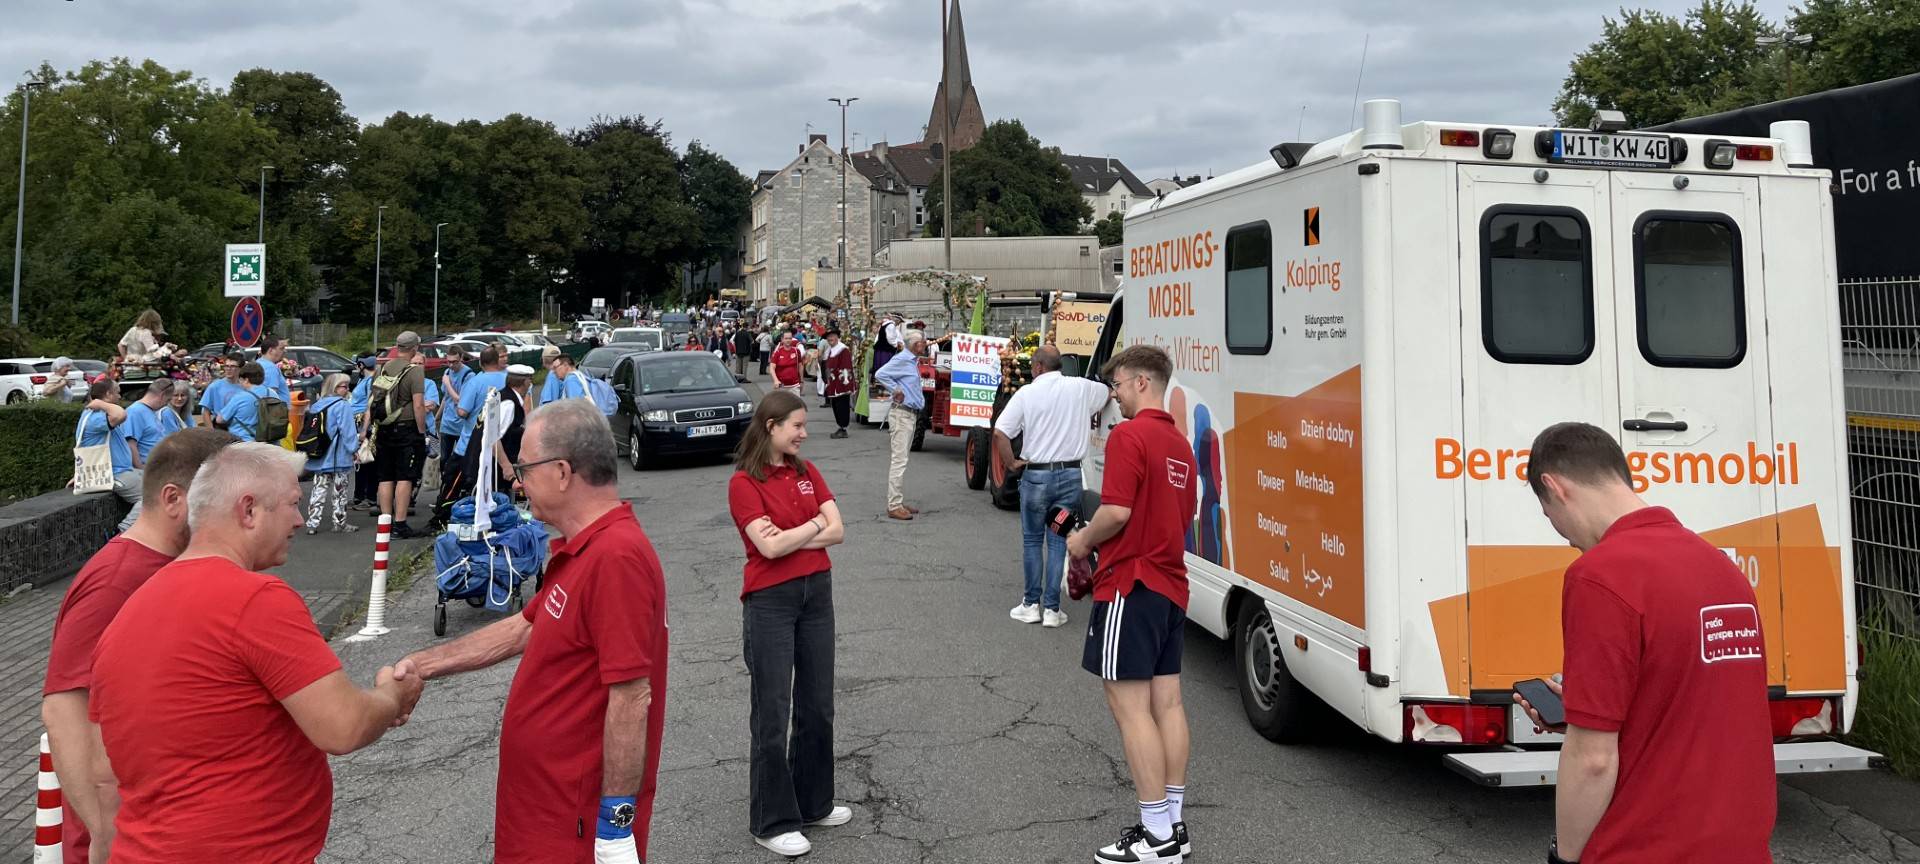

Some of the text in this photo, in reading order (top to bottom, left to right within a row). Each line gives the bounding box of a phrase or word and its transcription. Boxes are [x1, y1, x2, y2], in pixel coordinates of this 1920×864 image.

[1563, 135, 1600, 157] WIT
[1613, 138, 1639, 158] KW
[1644, 140, 1667, 160] 40
[1840, 168, 1878, 195] For
[1886, 169, 1902, 190] a
[1131, 230, 1219, 279] BERATUNGS-
[1286, 256, 1341, 292] Kolping
[1149, 281, 1195, 318] MOBIL
[1304, 313, 1345, 326] Bildungszentren
[1304, 329, 1317, 339] Ruhr
[1330, 328, 1347, 339] GmbH
[957, 355, 993, 365] WOCHE
[1173, 335, 1220, 373] Witten
[1267, 430, 1288, 449] Hallo
[1301, 419, 1354, 448] Dzień dobry
[1434, 437, 1800, 494] Beragsmobil
[1257, 469, 1286, 492] Привет
[1295, 468, 1335, 495] Merhaba
[1257, 511, 1288, 537] Bonjour
[1321, 532, 1345, 556] Hello
[1269, 559, 1290, 583] Salut
[1302, 552, 1333, 598] مرحبا
[1735, 627, 1757, 638] ruhr
